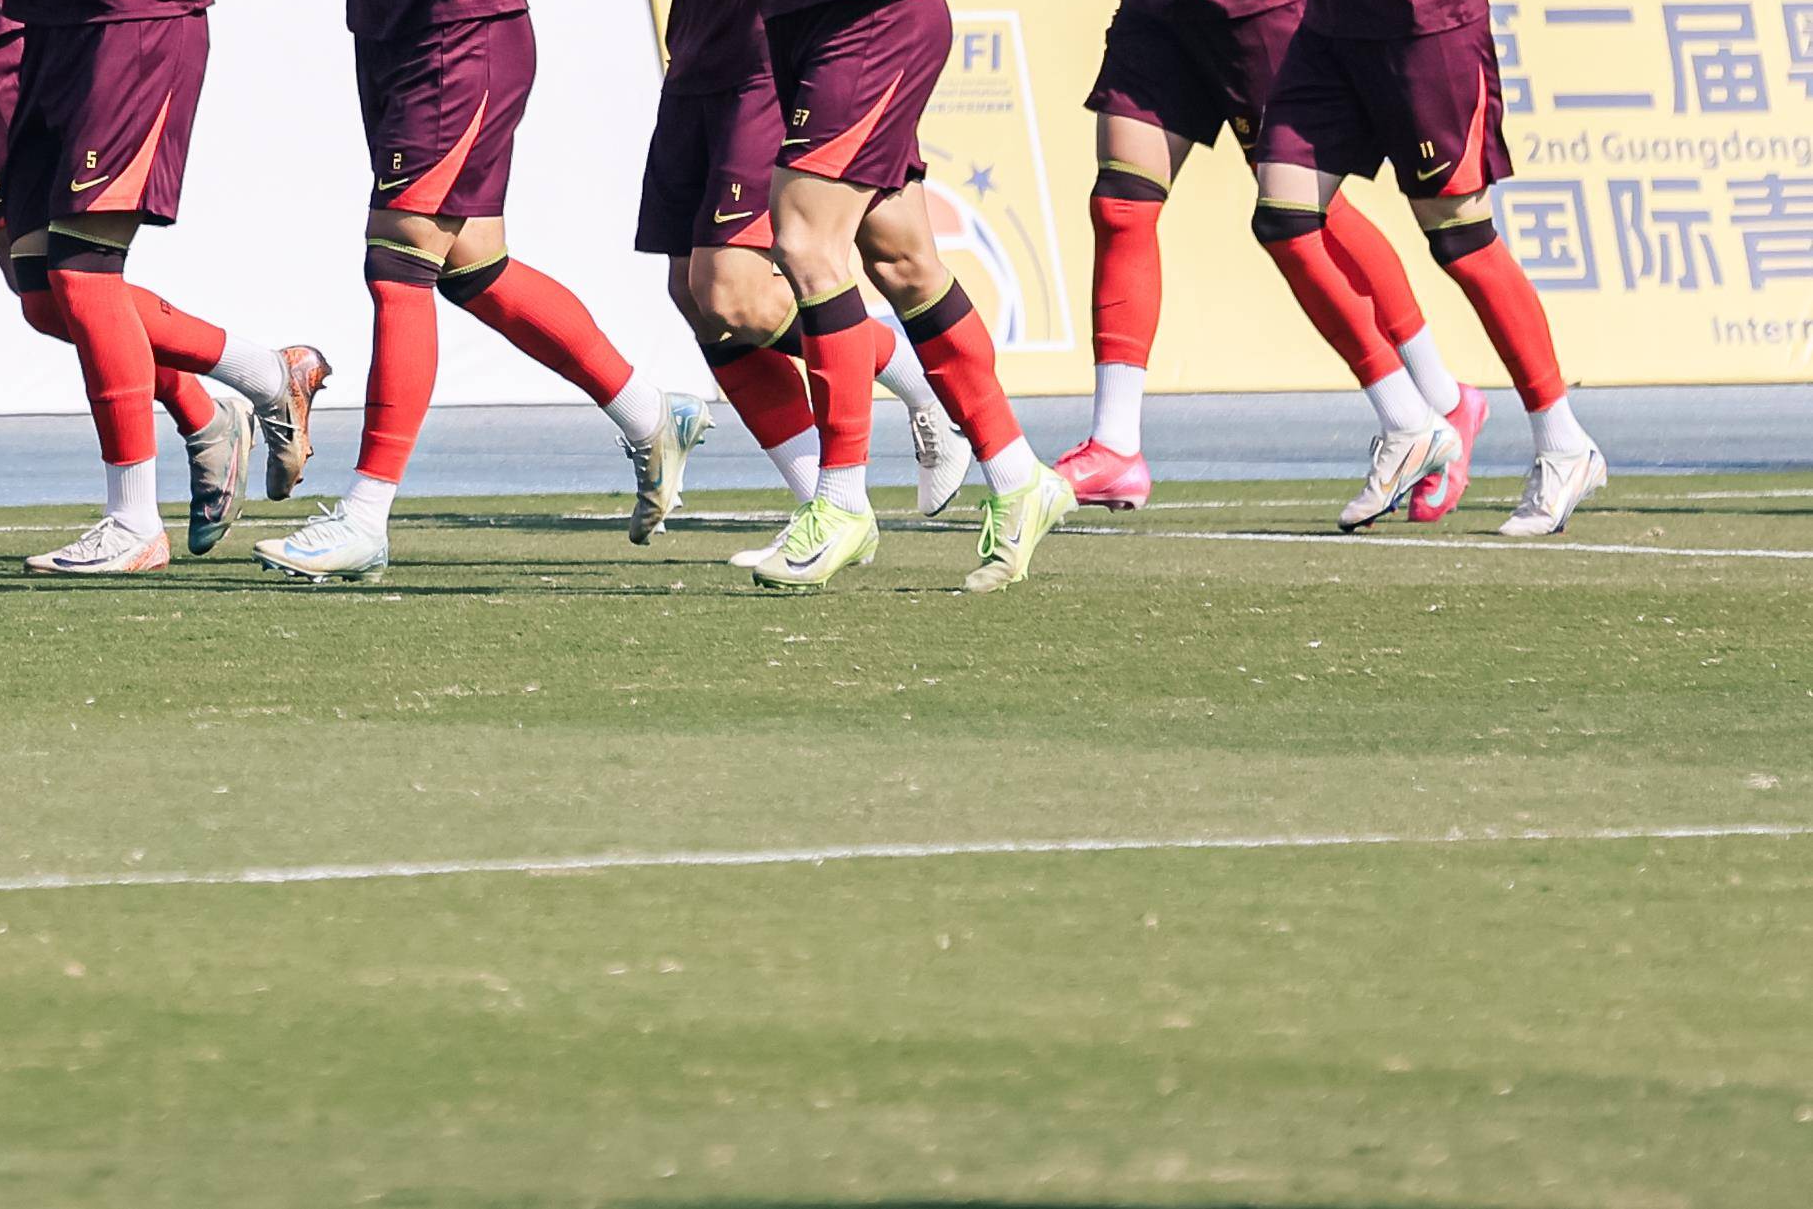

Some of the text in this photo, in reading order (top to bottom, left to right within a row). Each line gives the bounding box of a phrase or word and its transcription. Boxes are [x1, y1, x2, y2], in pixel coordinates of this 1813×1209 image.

[953, 33, 1002, 71] FI
[792, 108, 810, 127] 27
[1419, 140, 1435, 159] 11
[1525, 131, 1813, 169] 2nd Guangdong
[86, 150, 97, 169] 5
[393, 153, 402, 170] 2
[731, 183, 742, 202] 4
